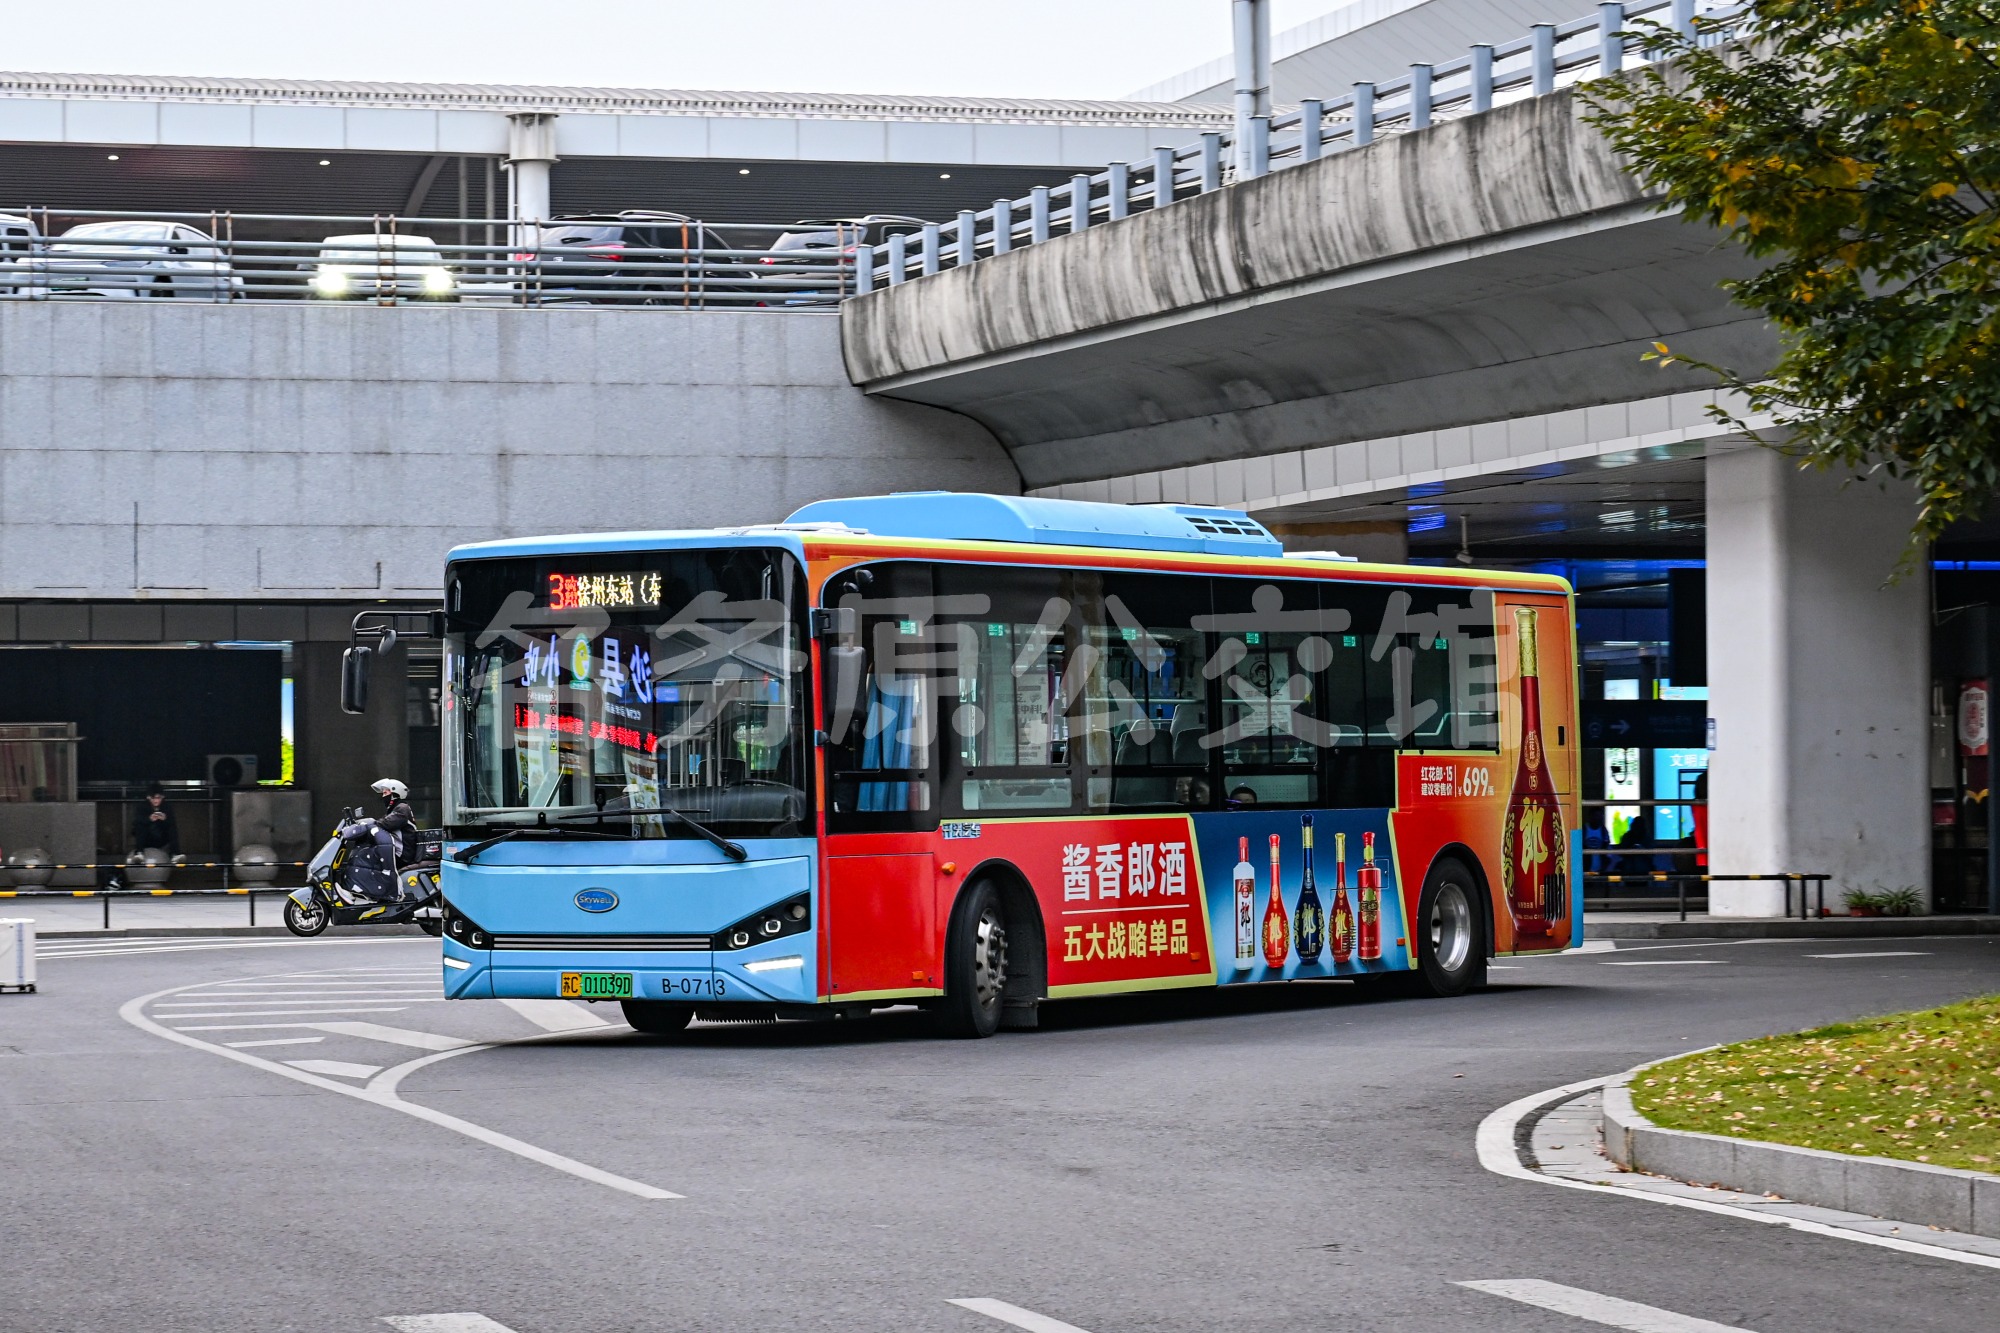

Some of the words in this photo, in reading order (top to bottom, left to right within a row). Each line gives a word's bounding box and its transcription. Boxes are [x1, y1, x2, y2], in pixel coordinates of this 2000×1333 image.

[1421, 783, 1453, 796] 建议零售价
[1061, 841, 1187, 902] 酱香郎酒
[1063, 918, 1189, 963] 五大战略单品
[662, 977, 726, 996] B-0713
